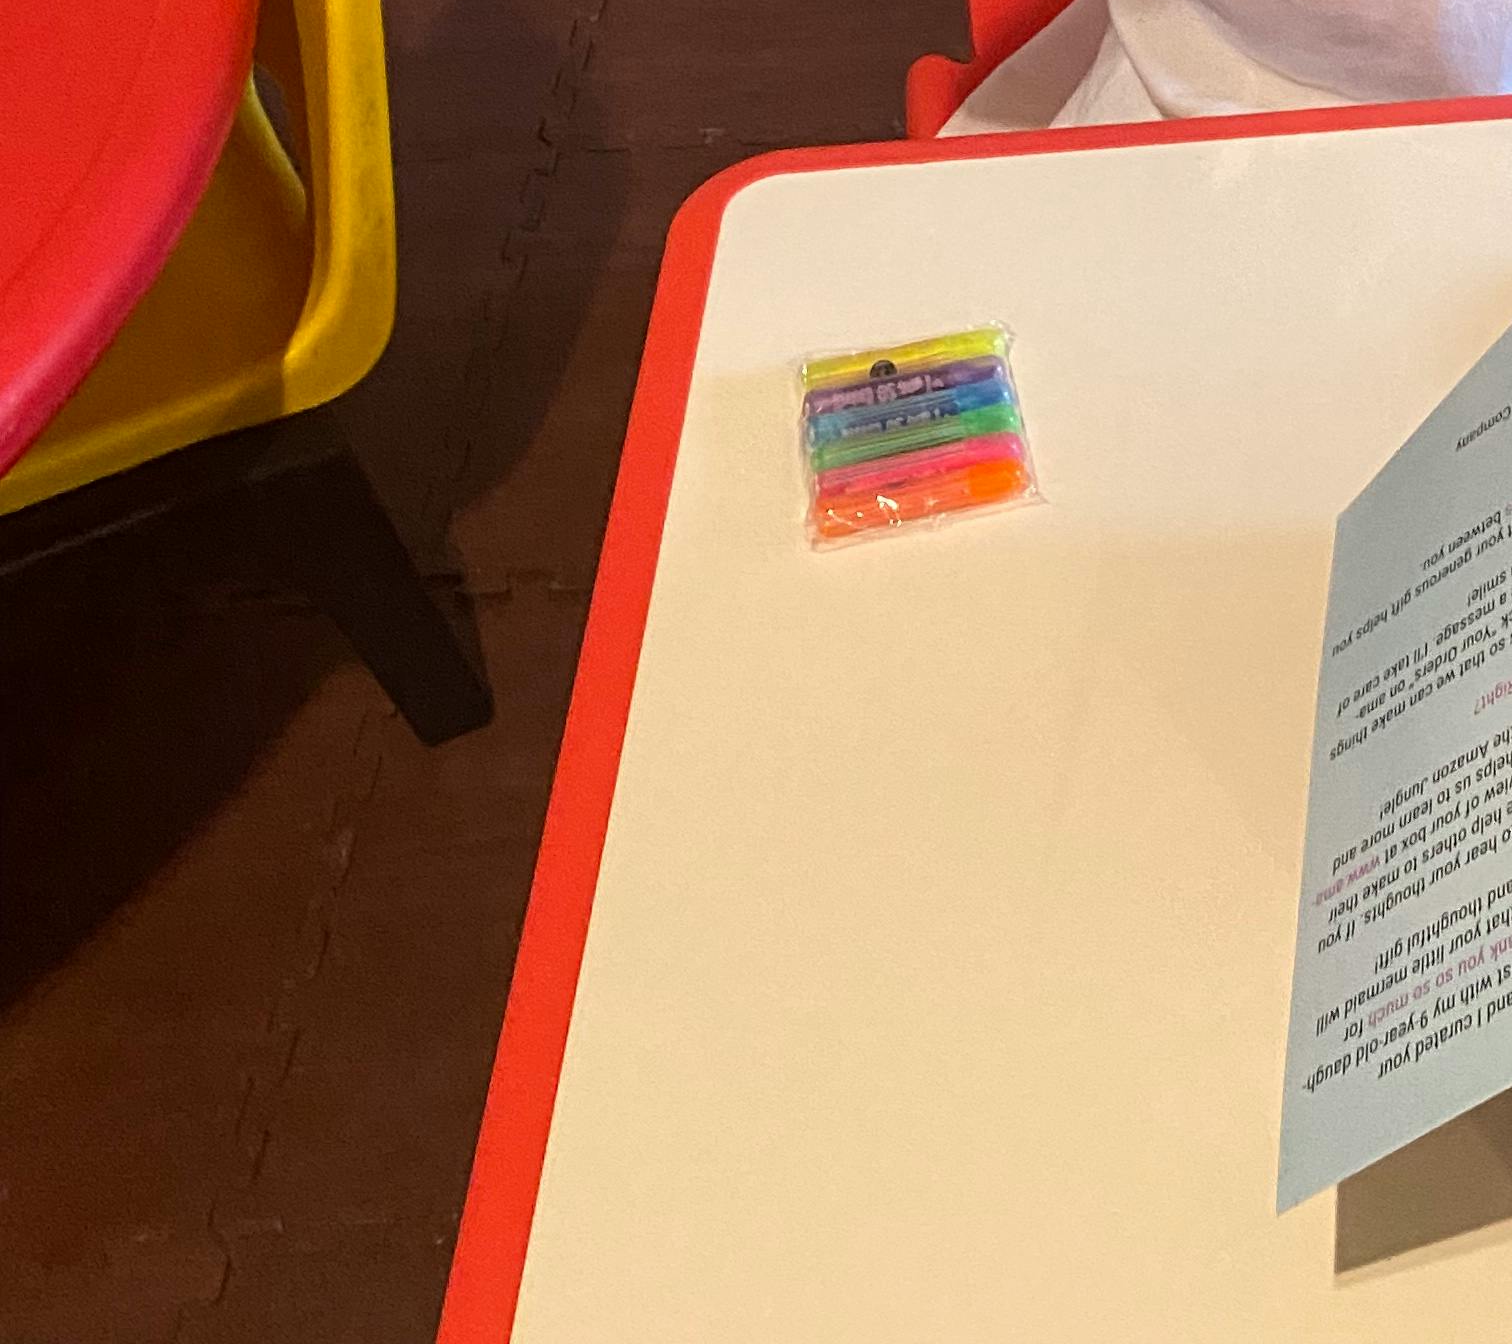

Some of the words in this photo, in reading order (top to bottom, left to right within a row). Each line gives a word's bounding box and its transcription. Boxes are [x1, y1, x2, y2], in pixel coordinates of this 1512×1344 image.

[1455, 405, 1511, 452] Company
[1406, 896, 1482, 955] thoughtful
[1448, 918, 1481, 954] your
[1411, 943, 1444, 975] little
[1457, 944, 1485, 976] you
[1343, 965, 1407, 1019] mermaid
[1411, 978, 1430, 1000] so
[1434, 967, 1453, 988] so
[1459, 974, 1492, 1006] with
[1315, 1005, 1340, 1037] will
[1367, 992, 1409, 1028] much
[1432, 993, 1455, 1018] my
[1477, 1007, 1481, 1027] I
[1342, 1018, 1363, 1042] for
[1414, 1013, 1472, 1063] curated
[1377, 1041, 1410, 1079] your
